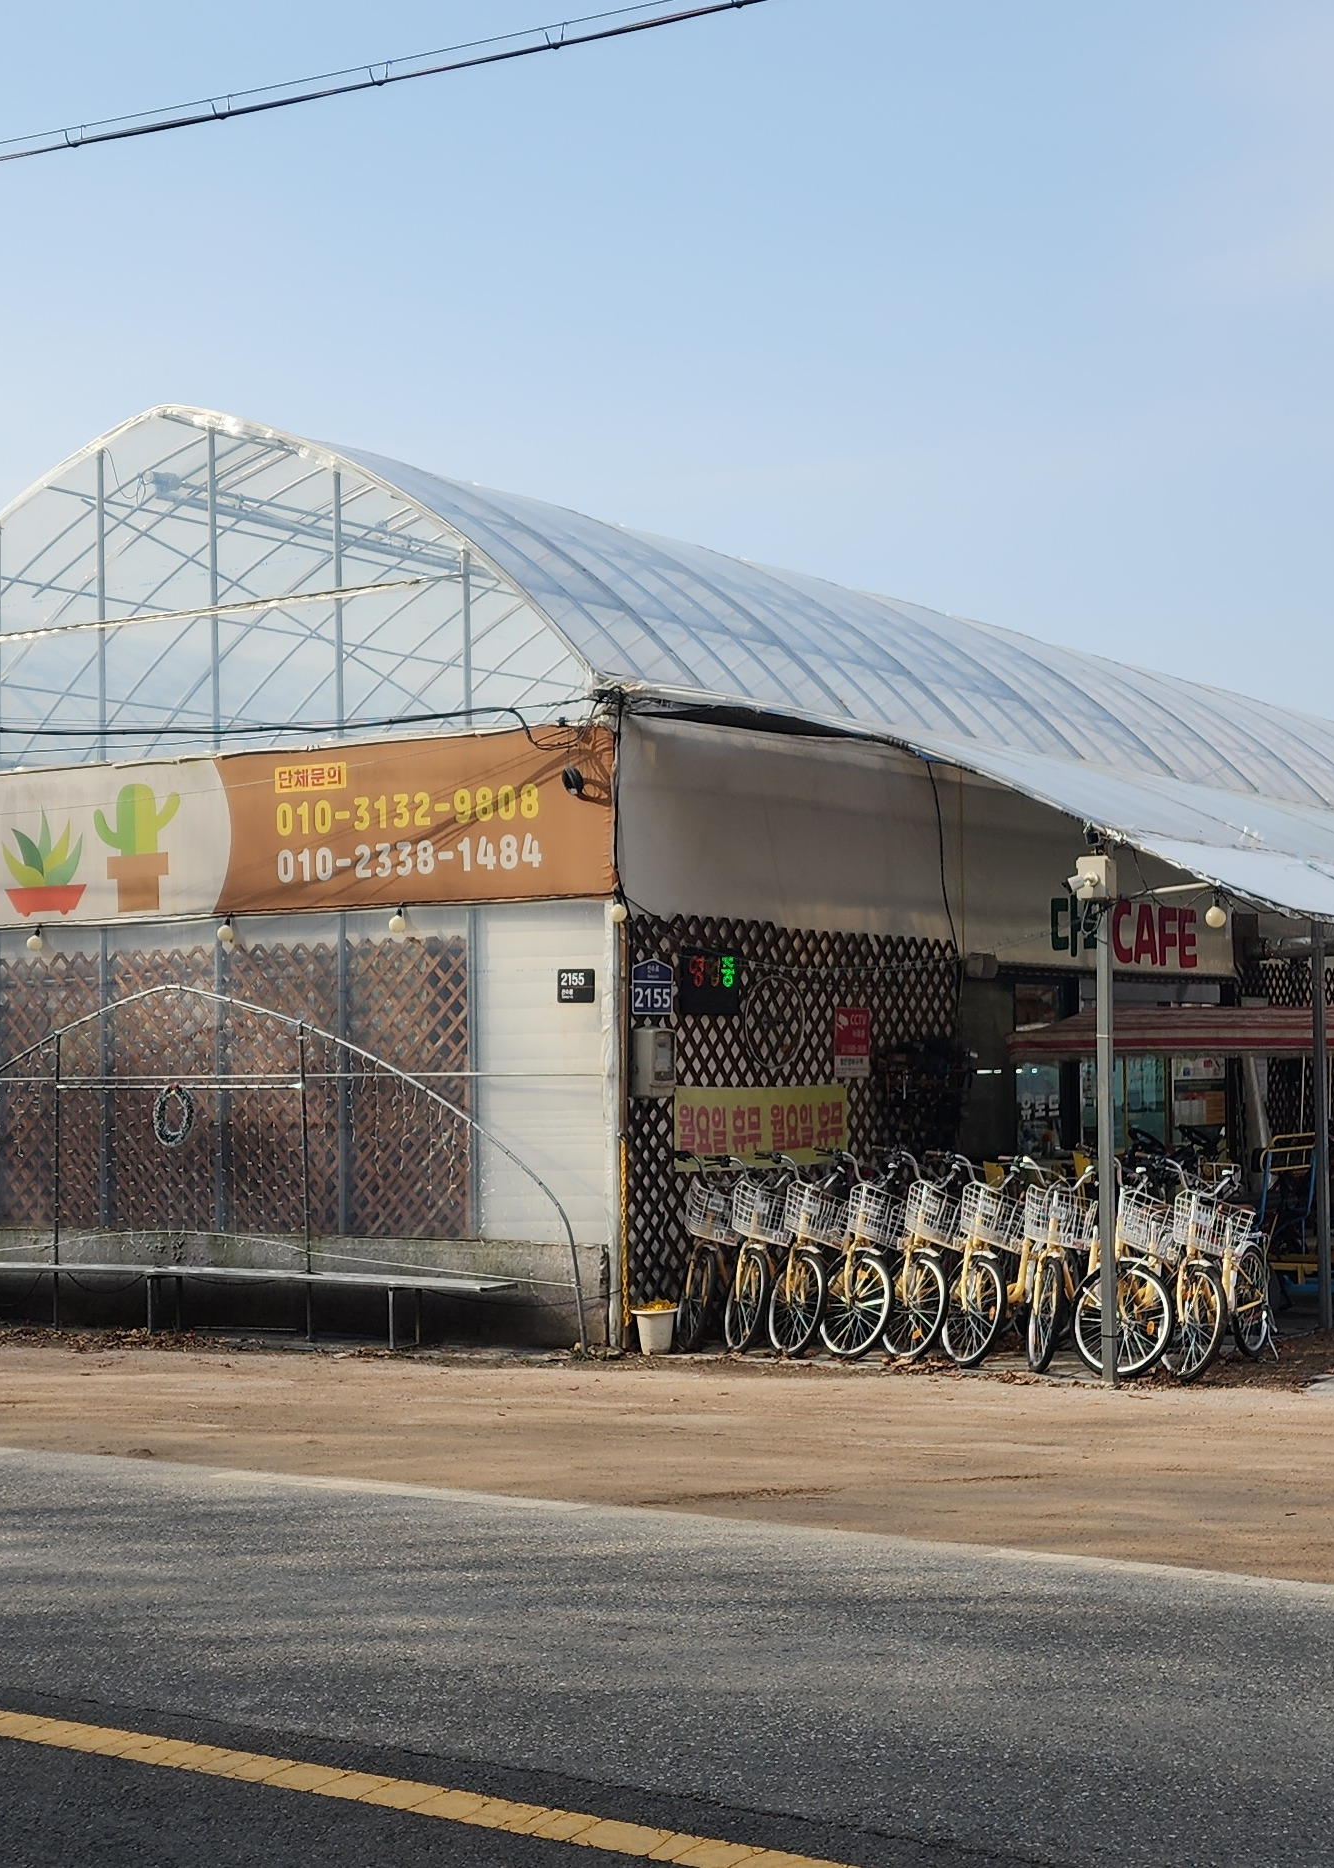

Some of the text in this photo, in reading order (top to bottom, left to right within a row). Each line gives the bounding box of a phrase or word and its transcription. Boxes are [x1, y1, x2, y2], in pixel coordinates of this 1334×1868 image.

[277, 765, 343, 789] 단체문의
[276, 783, 540, 836] 010-3132-9808
[277, 832, 542, 883] 010-2338-1484
[560, 972, 585, 986] 2155
[634, 987, 671, 1008] 2155
[850, 1014, 867, 1026] CCTV
[679, 1102, 843, 1154] 월요일 휴무 월요일 휴무
